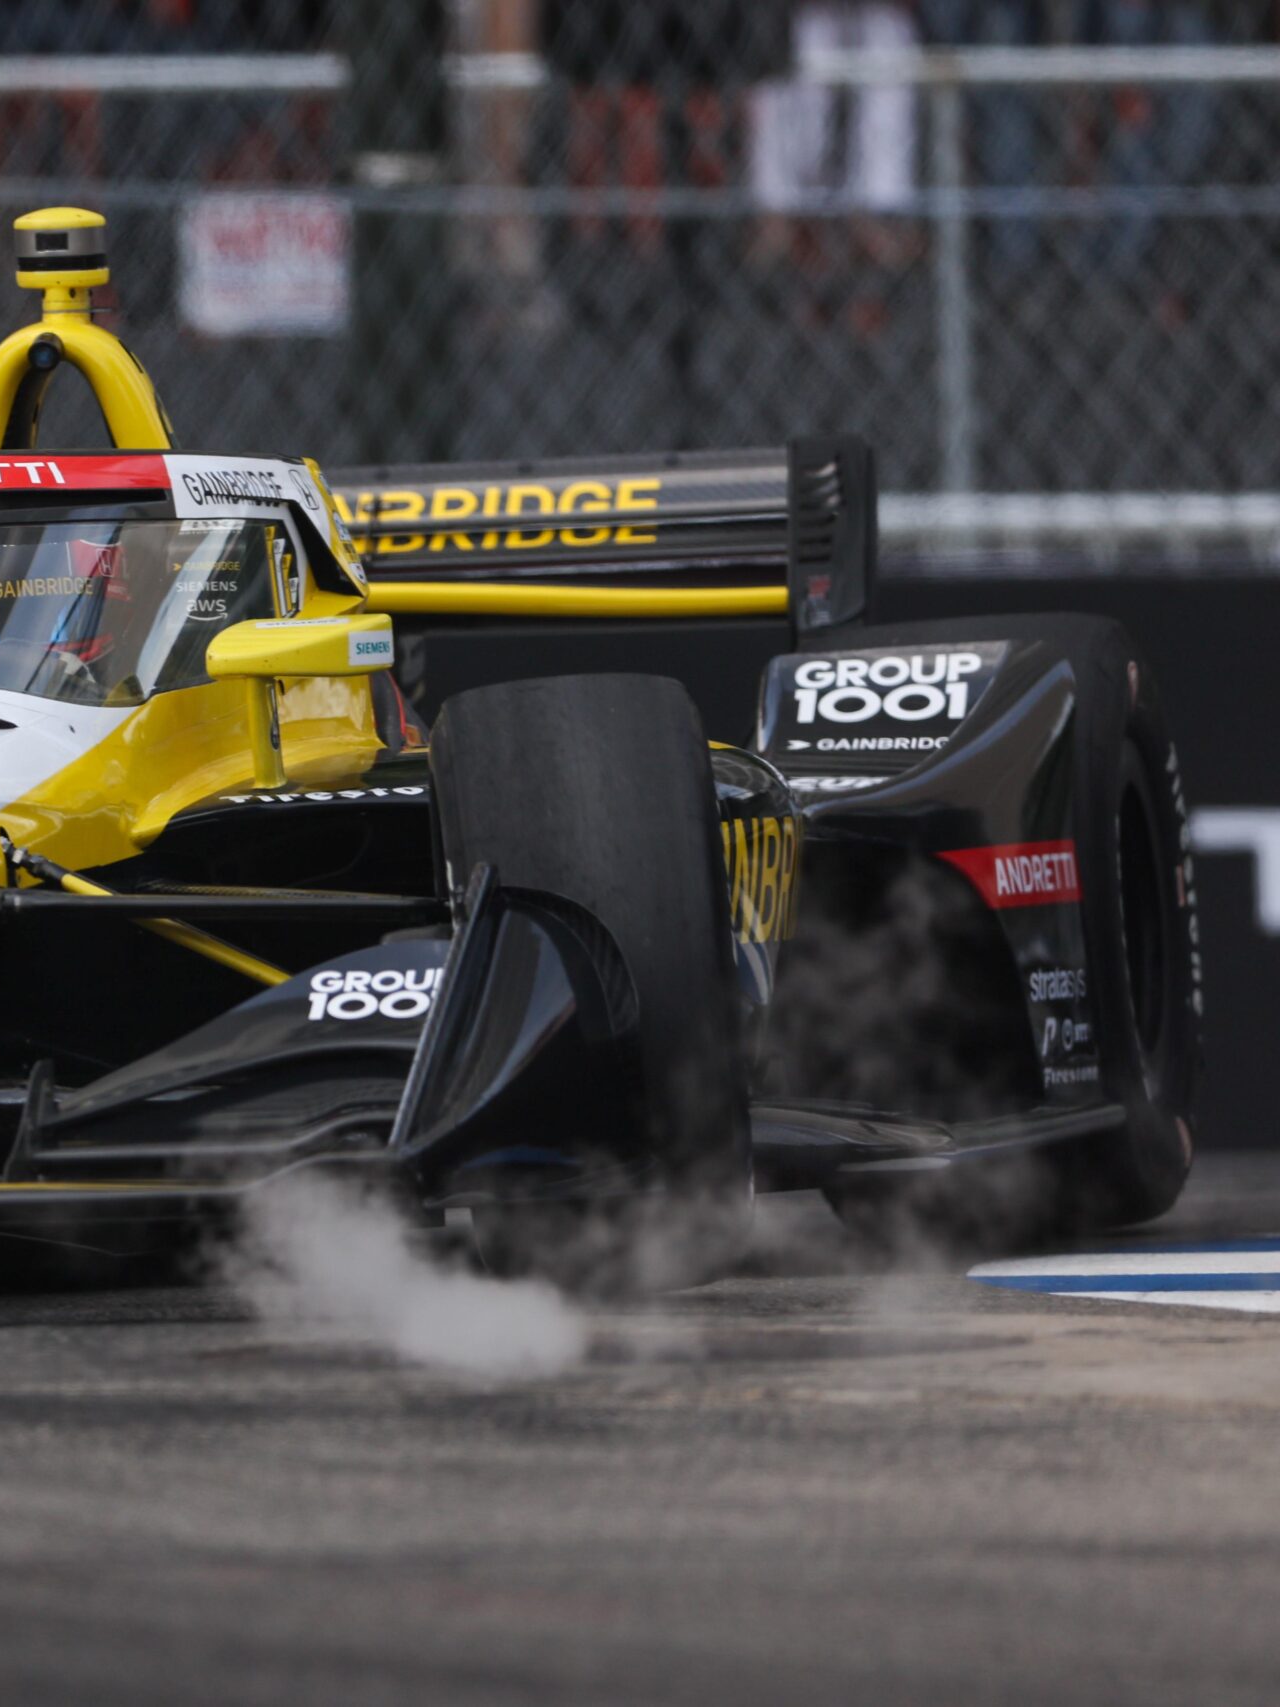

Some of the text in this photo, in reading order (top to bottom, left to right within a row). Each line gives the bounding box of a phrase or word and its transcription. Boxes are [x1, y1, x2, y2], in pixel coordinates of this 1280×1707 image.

[181, 470, 284, 507] GAINBRIDGE
[332, 478, 662, 556] NBRIDGE
[175, 581, 238, 593] SIEMENS
[186, 599, 227, 613] aws
[355, 641, 391, 656] SIEMENS
[794, 652, 982, 690] GROUP
[794, 681, 968, 724] 1001
[816, 736, 950, 752] GAINBRIDG
[218, 785, 430, 804] Firesto
[994, 852, 1078, 897] ANDRETTI
[308, 988, 437, 1021] 100
